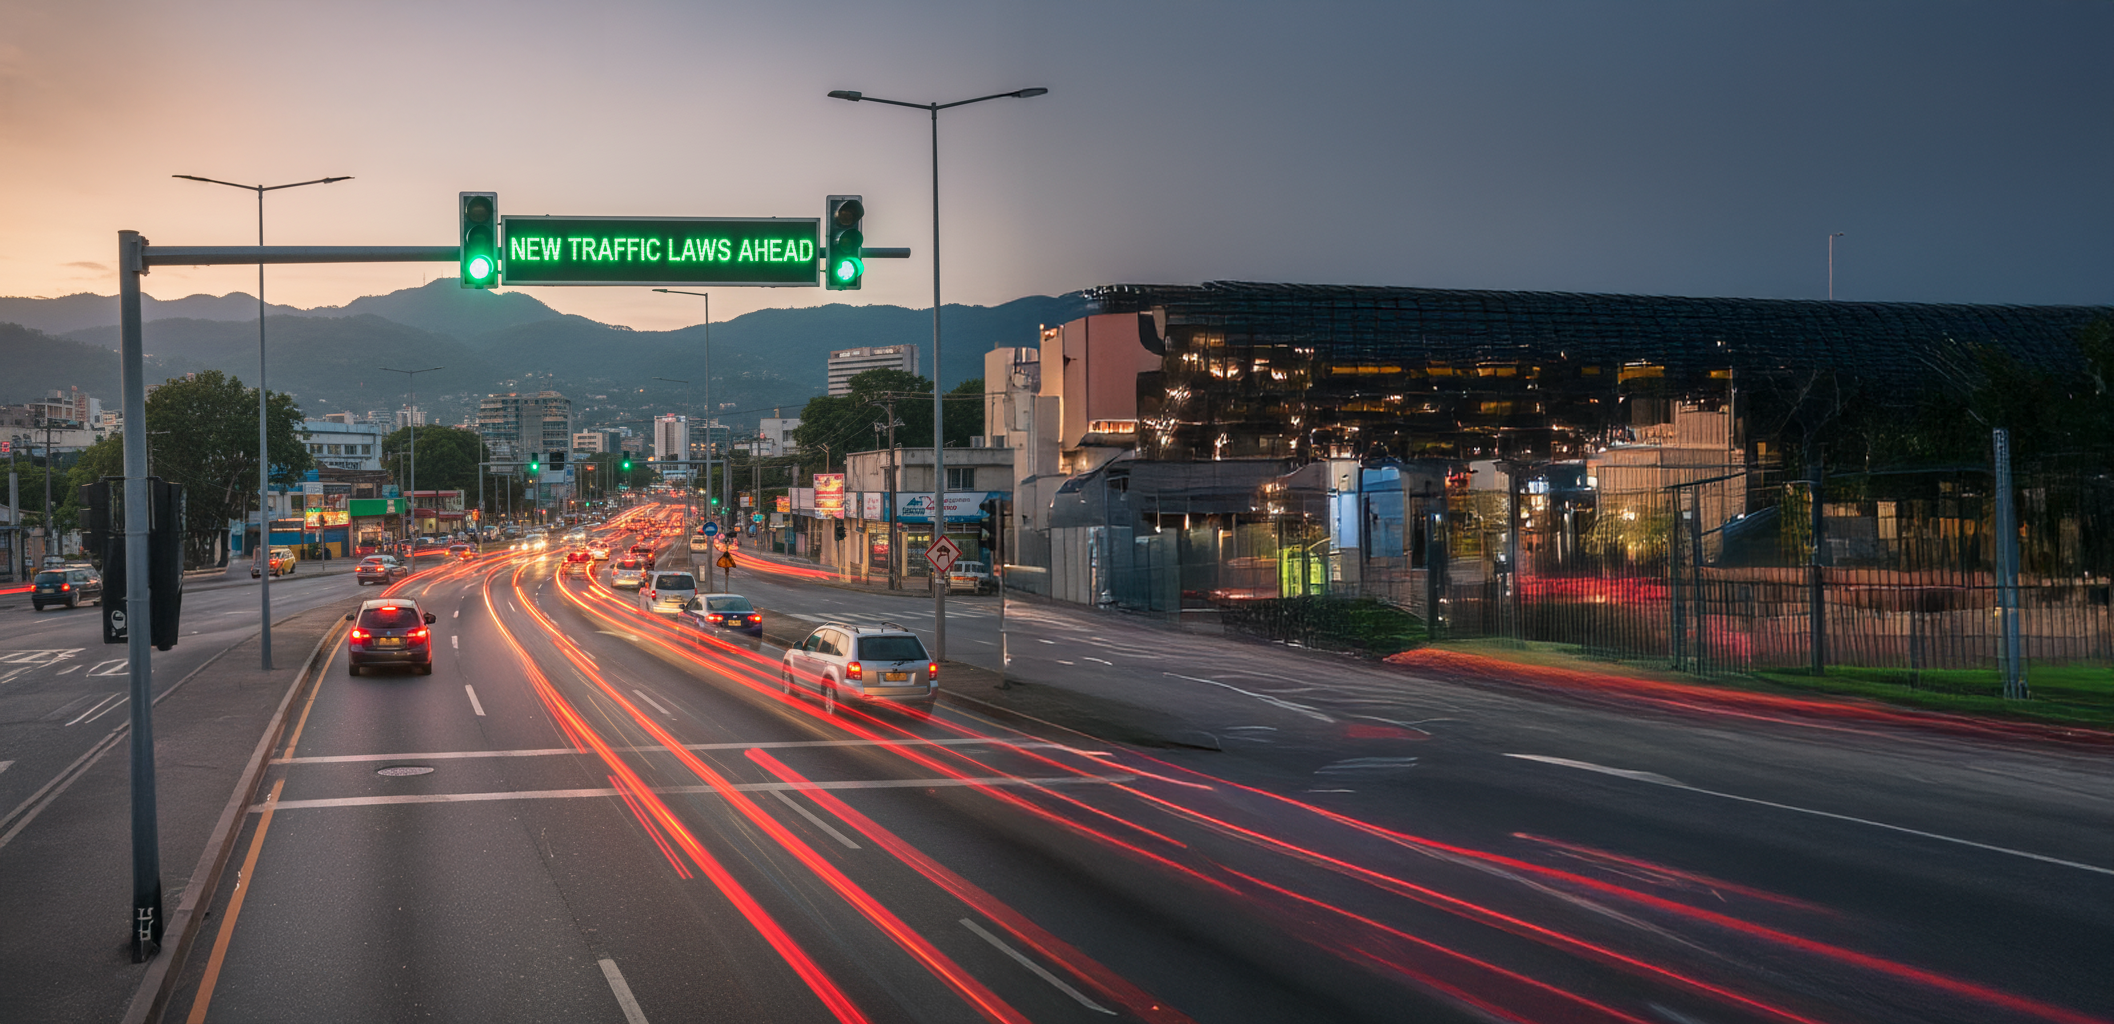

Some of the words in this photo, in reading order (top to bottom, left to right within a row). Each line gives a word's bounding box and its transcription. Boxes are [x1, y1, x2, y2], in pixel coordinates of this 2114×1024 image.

[511, 237, 562, 261] NEW
[568, 237, 661, 262] TRAFFIC
[668, 238, 731, 262] LAWS
[738, 239, 813, 262] AHEAD
